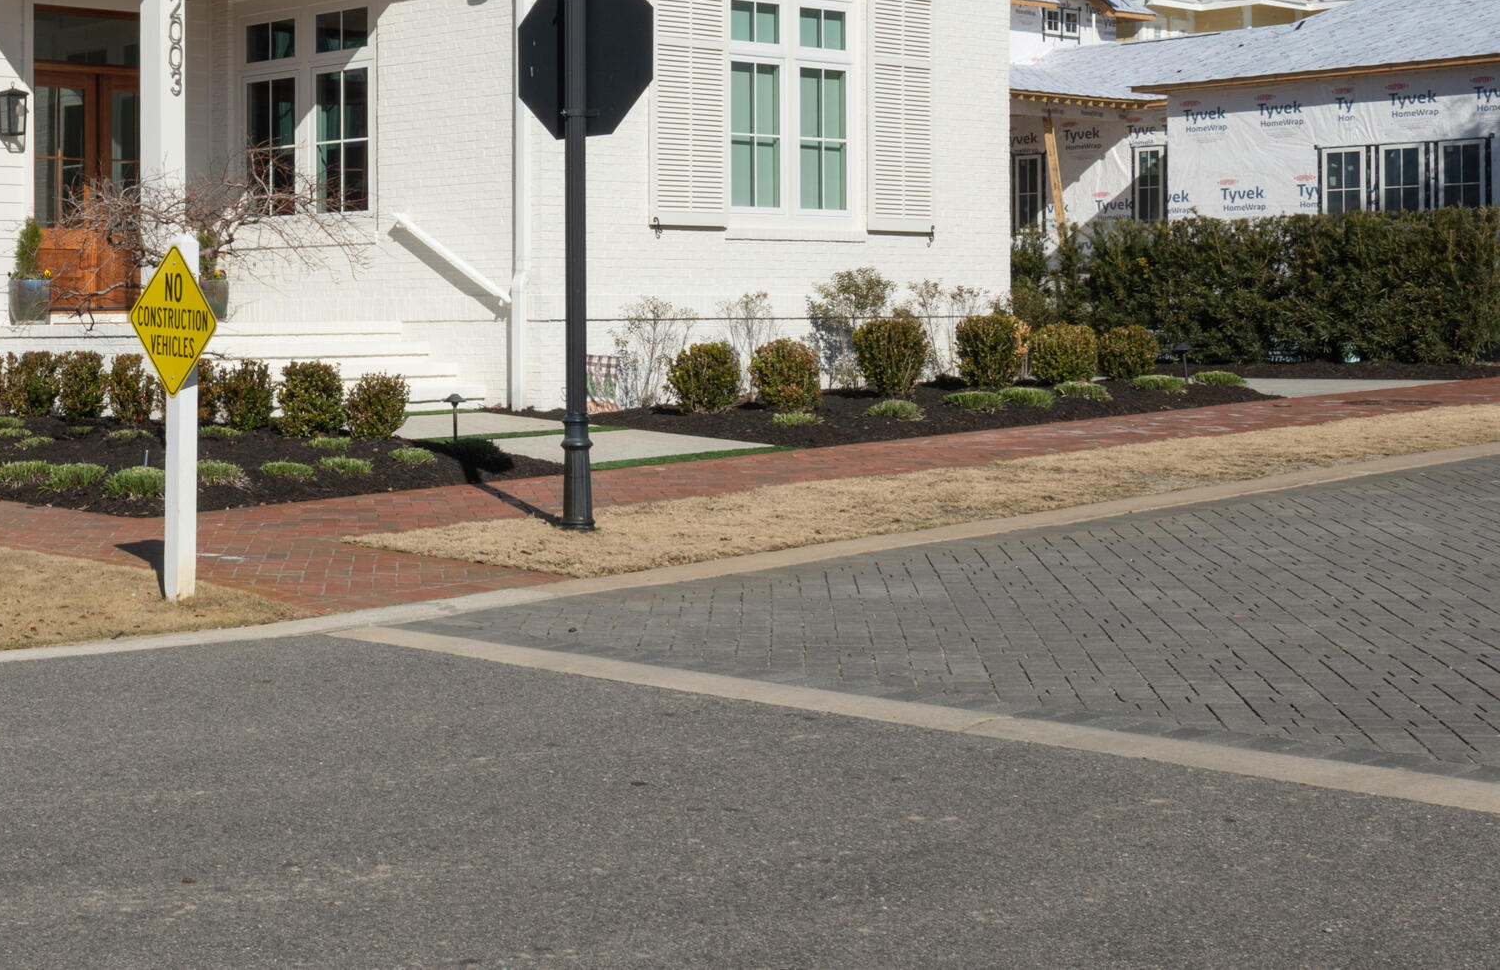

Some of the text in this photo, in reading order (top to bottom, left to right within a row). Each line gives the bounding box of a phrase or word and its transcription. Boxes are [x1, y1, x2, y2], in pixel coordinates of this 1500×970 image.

[1388, 89, 1437, 109] Tyvek
[1473, 86, 1500, 103] Tyv
[1183, 106, 1226, 125] Tyvek
[1257, 100, 1303, 119] Tyvek
[1391, 108, 1440, 119] HomeWrap
[1126, 124, 1156, 140] Tyve
[1185, 124, 1228, 134] HomeWrap
[1260, 119, 1305, 128] HomeWrap
[1009, 132, 1038, 148] yvek
[1063, 127, 1100, 144] Tyvek
[1220, 185, 1264, 204] Tyvek
[1095, 198, 1133, 214] Tyvek
[1223, 203, 1267, 213] HomeWrap
[164, 272, 183, 303] NO
[137, 306, 208, 332] CONSTRUCTION
[150, 334, 195, 359] VEHICLES
